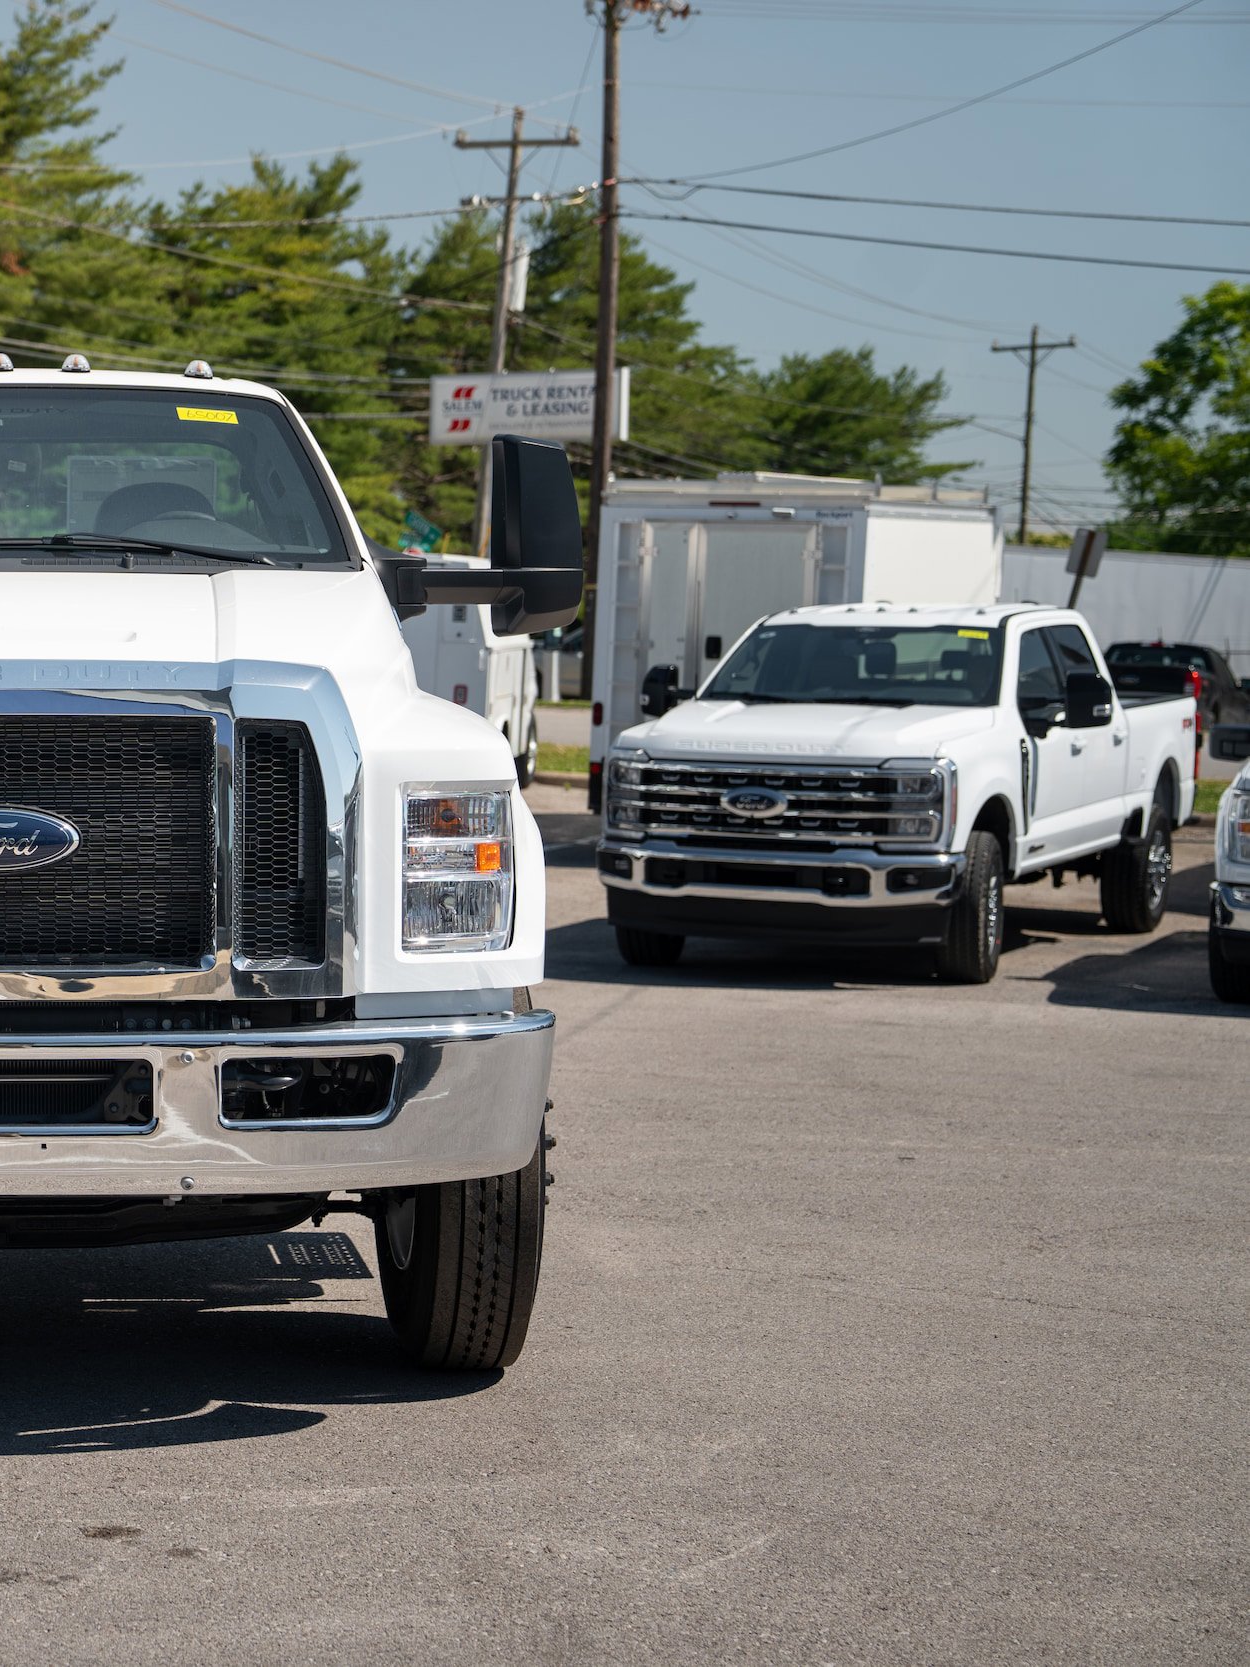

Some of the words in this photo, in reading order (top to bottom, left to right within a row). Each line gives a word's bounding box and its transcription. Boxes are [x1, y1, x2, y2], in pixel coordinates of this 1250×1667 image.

[492, 387, 541, 401] TRUCK
[547, 385, 597, 399] RENTA
[442, 400, 483, 412] SALEM
[506, 403, 518, 417] &
[522, 400, 590, 417] LEASING
[33, 664, 191, 683] DUTY
